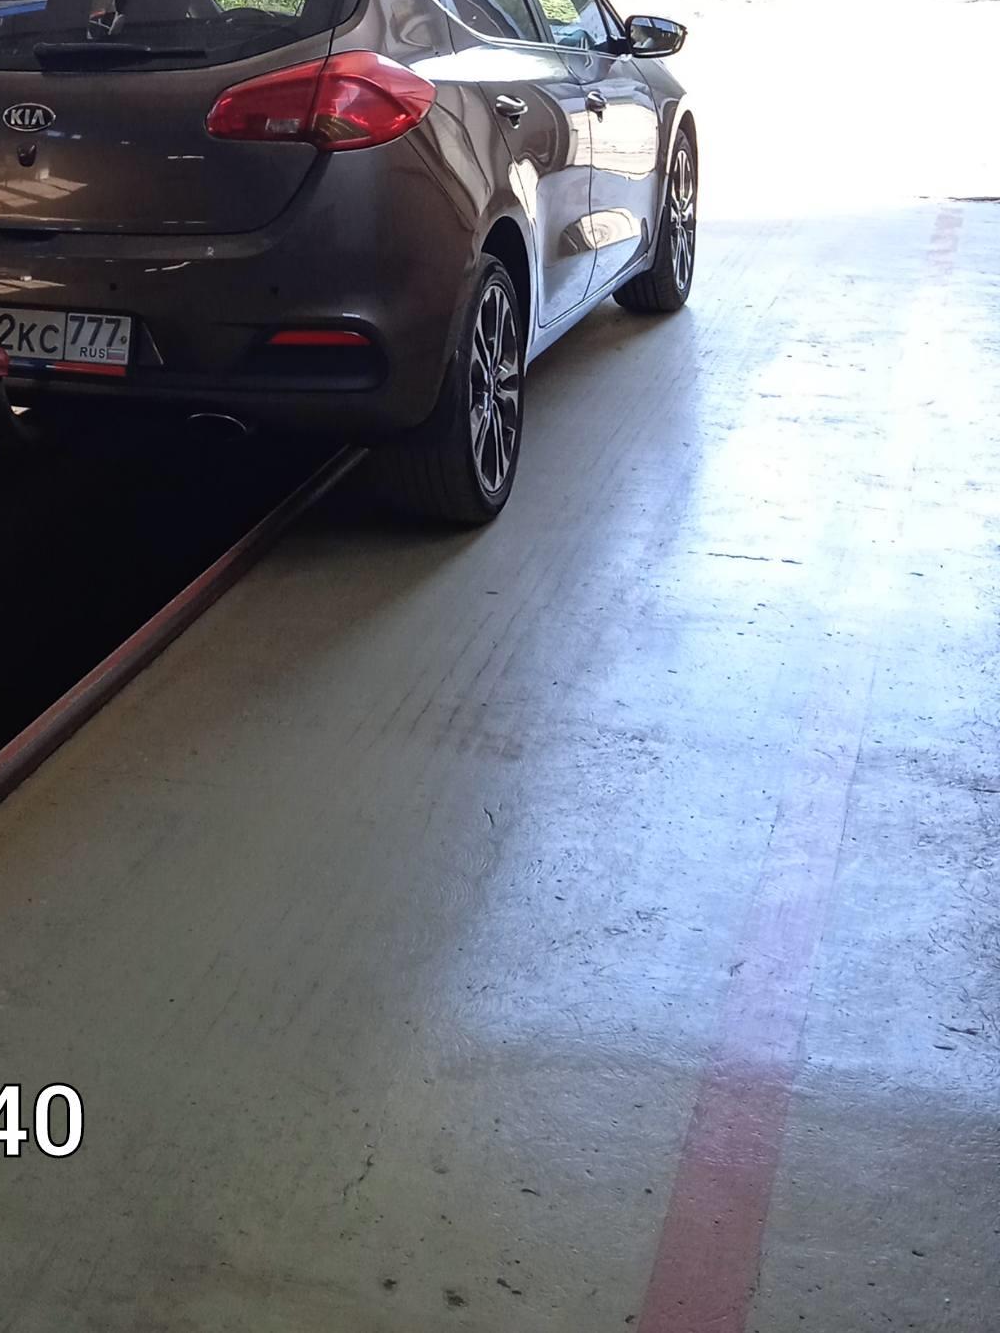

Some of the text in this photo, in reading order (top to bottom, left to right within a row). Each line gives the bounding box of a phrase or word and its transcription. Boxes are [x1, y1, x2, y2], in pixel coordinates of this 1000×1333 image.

[10, 108, 46, 127] KIA
[68, 314, 123, 347] 777
[79, 346, 106, 359] RUS
